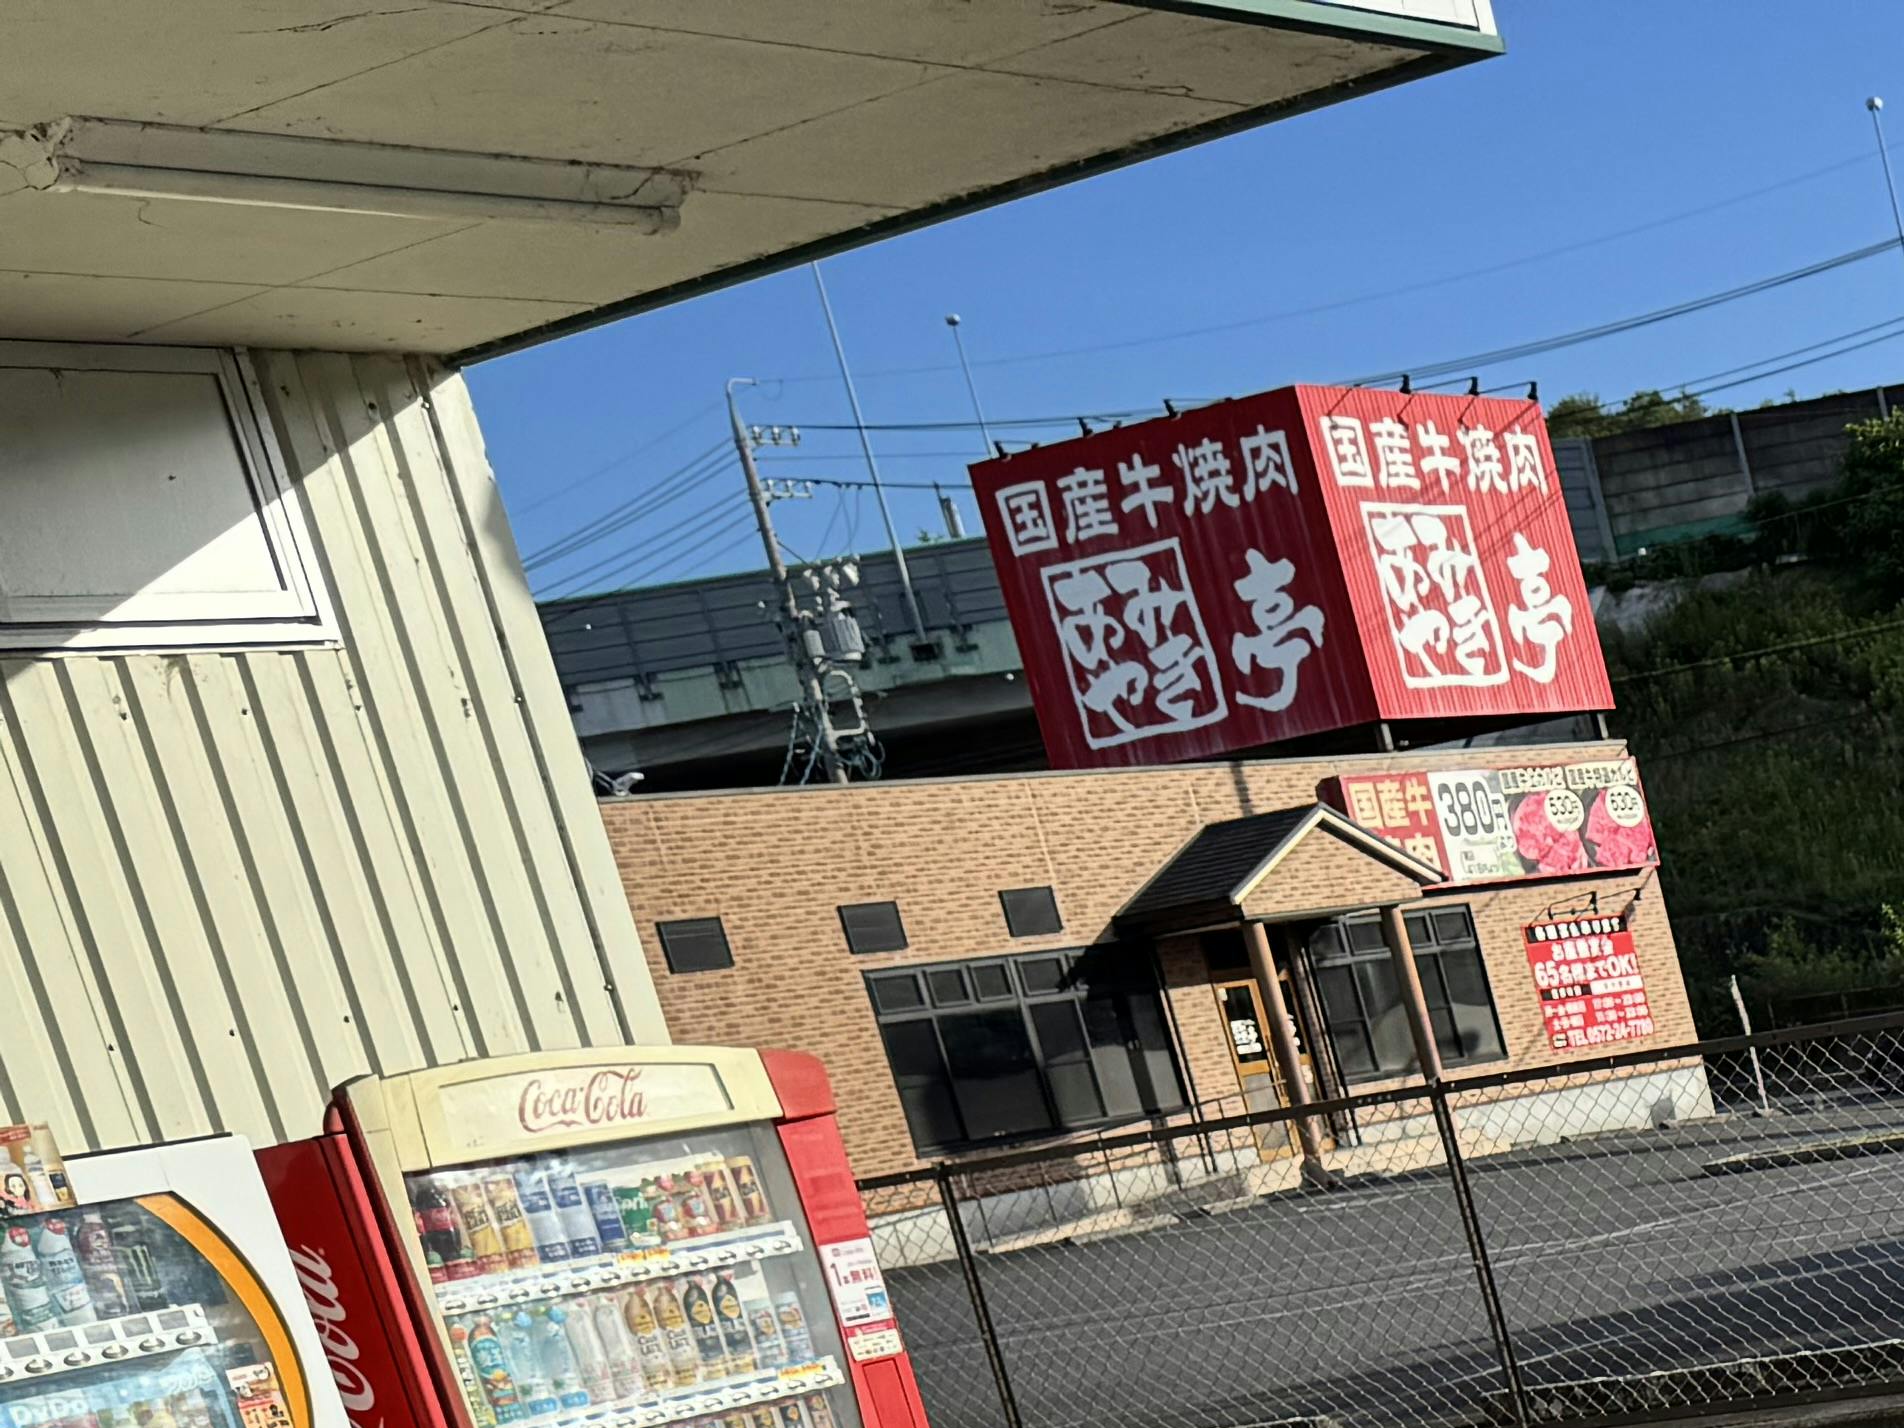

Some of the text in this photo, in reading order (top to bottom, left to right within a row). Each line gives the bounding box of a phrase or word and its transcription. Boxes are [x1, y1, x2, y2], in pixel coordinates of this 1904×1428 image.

[995, 425, 1299, 556] 国産牛焼肉
[1320, 416, 1548, 496] 国産牛焼肉
[1053, 548, 1325, 732] あみやき 亭
[1372, 515, 1572, 683] あみやき 亭
[1348, 778, 1434, 829] 国産牛
[519, 1068, 647, 1132] Coca-Cola
